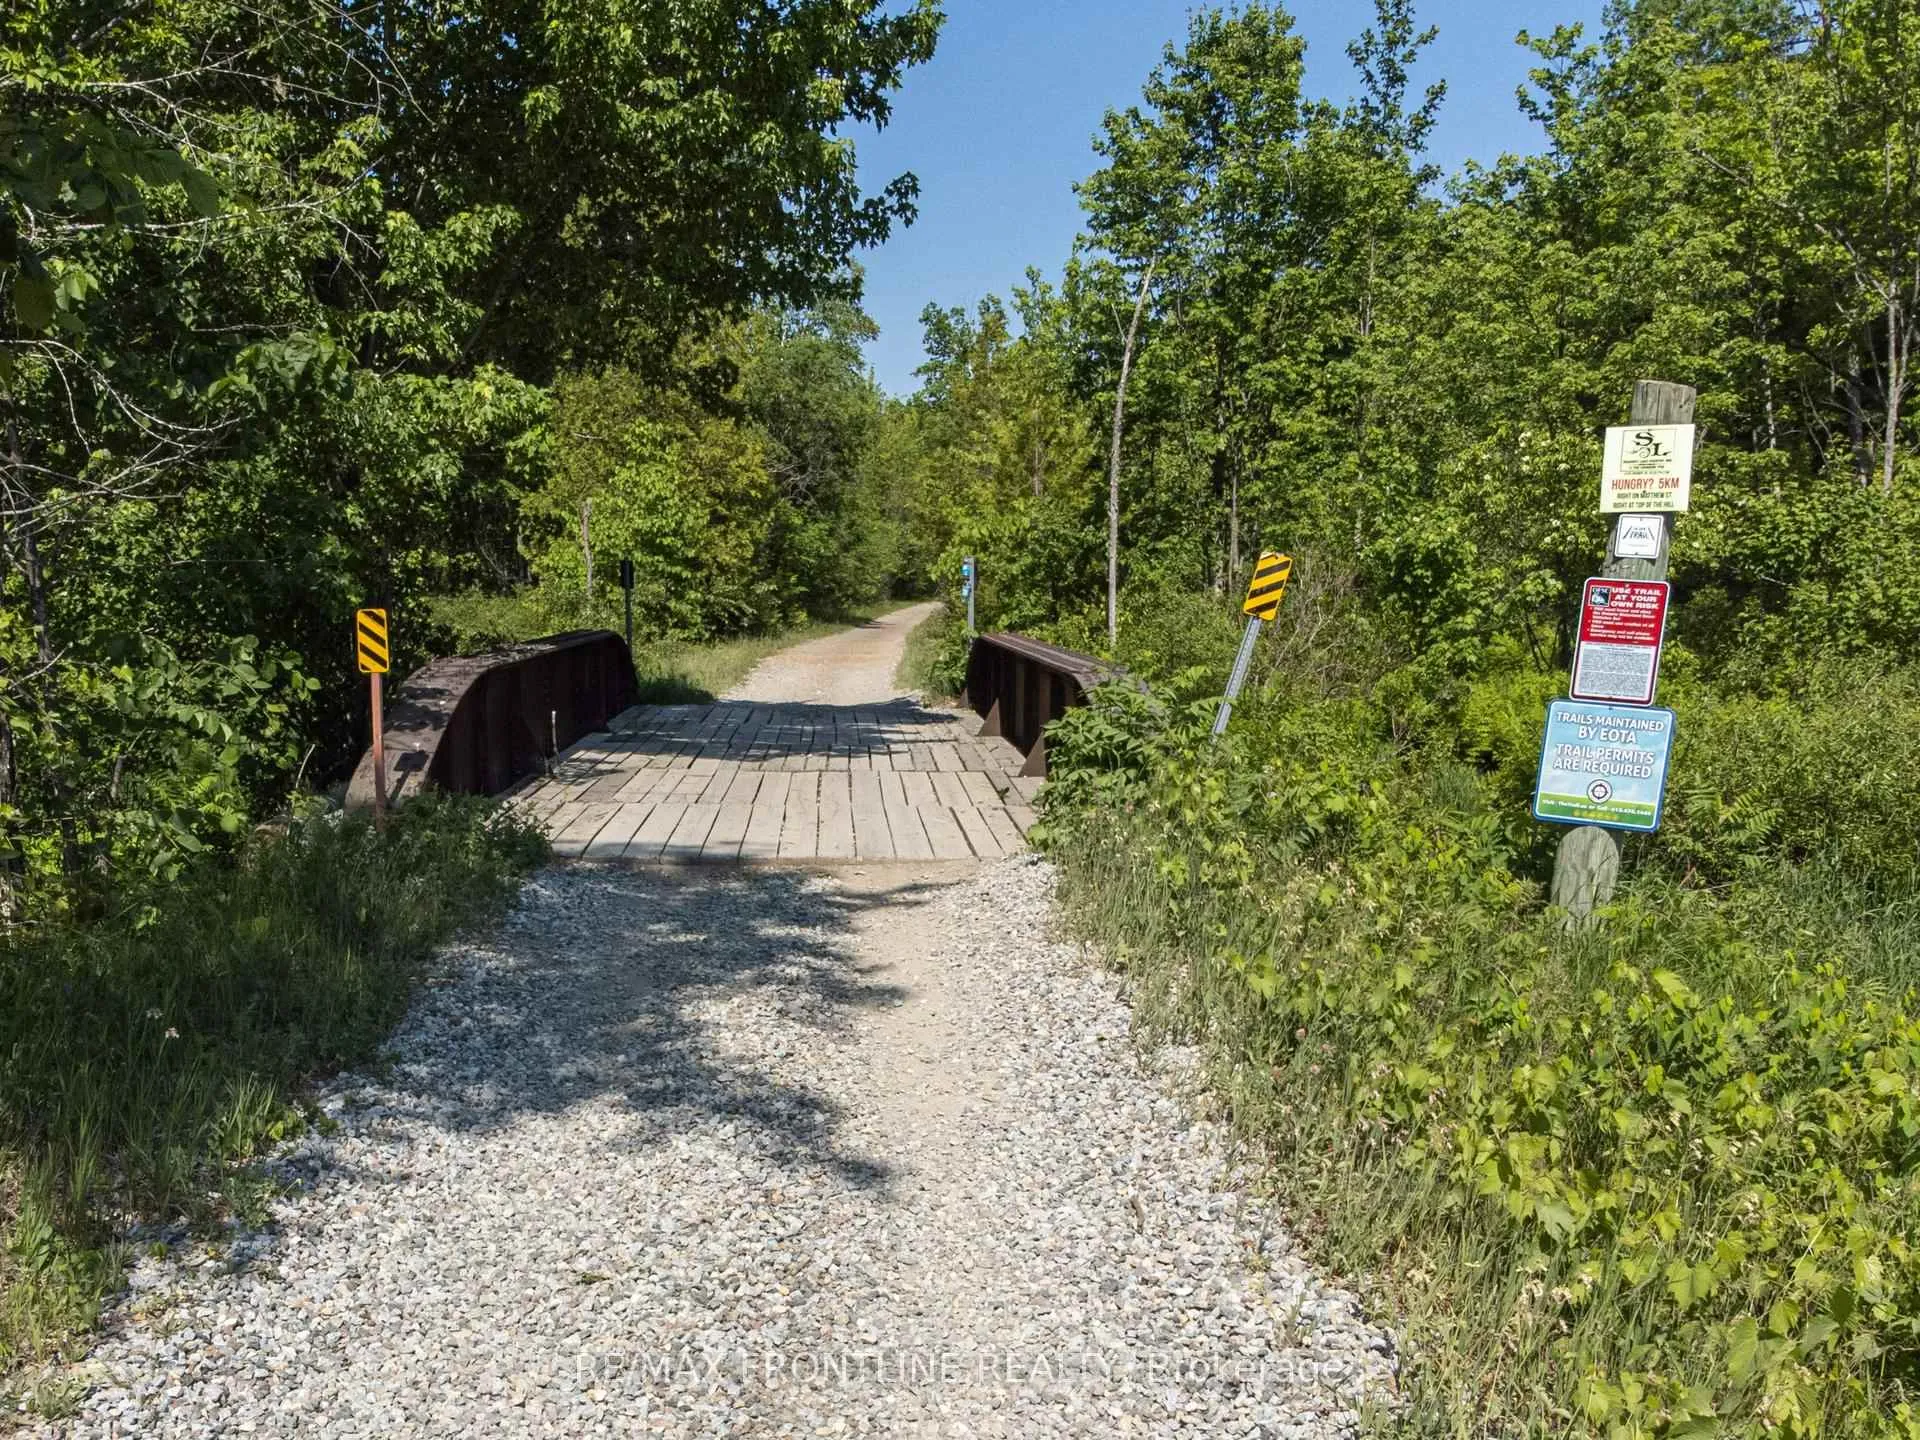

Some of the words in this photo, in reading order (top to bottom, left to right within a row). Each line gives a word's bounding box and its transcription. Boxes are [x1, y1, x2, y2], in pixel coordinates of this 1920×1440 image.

[1611, 478, 1654, 490] HUNGRY?
[1658, 477, 1680, 489] 5KM
[1633, 588, 1662, 596] TRAIL
[1635, 602, 1659, 610] RISK
[1556, 711, 1593, 725] TRAILS
[1595, 716, 1665, 731] MAINTAINED
[1578, 725, 1598, 739] BY
[1600, 728, 1637, 744] EOTA
[1555, 743, 1594, 759] TRAIL
[1596, 748, 1655, 765] PERMITS
[1552, 758, 1579, 771] ARE
[1583, 761, 1652, 779] REQUIRED
